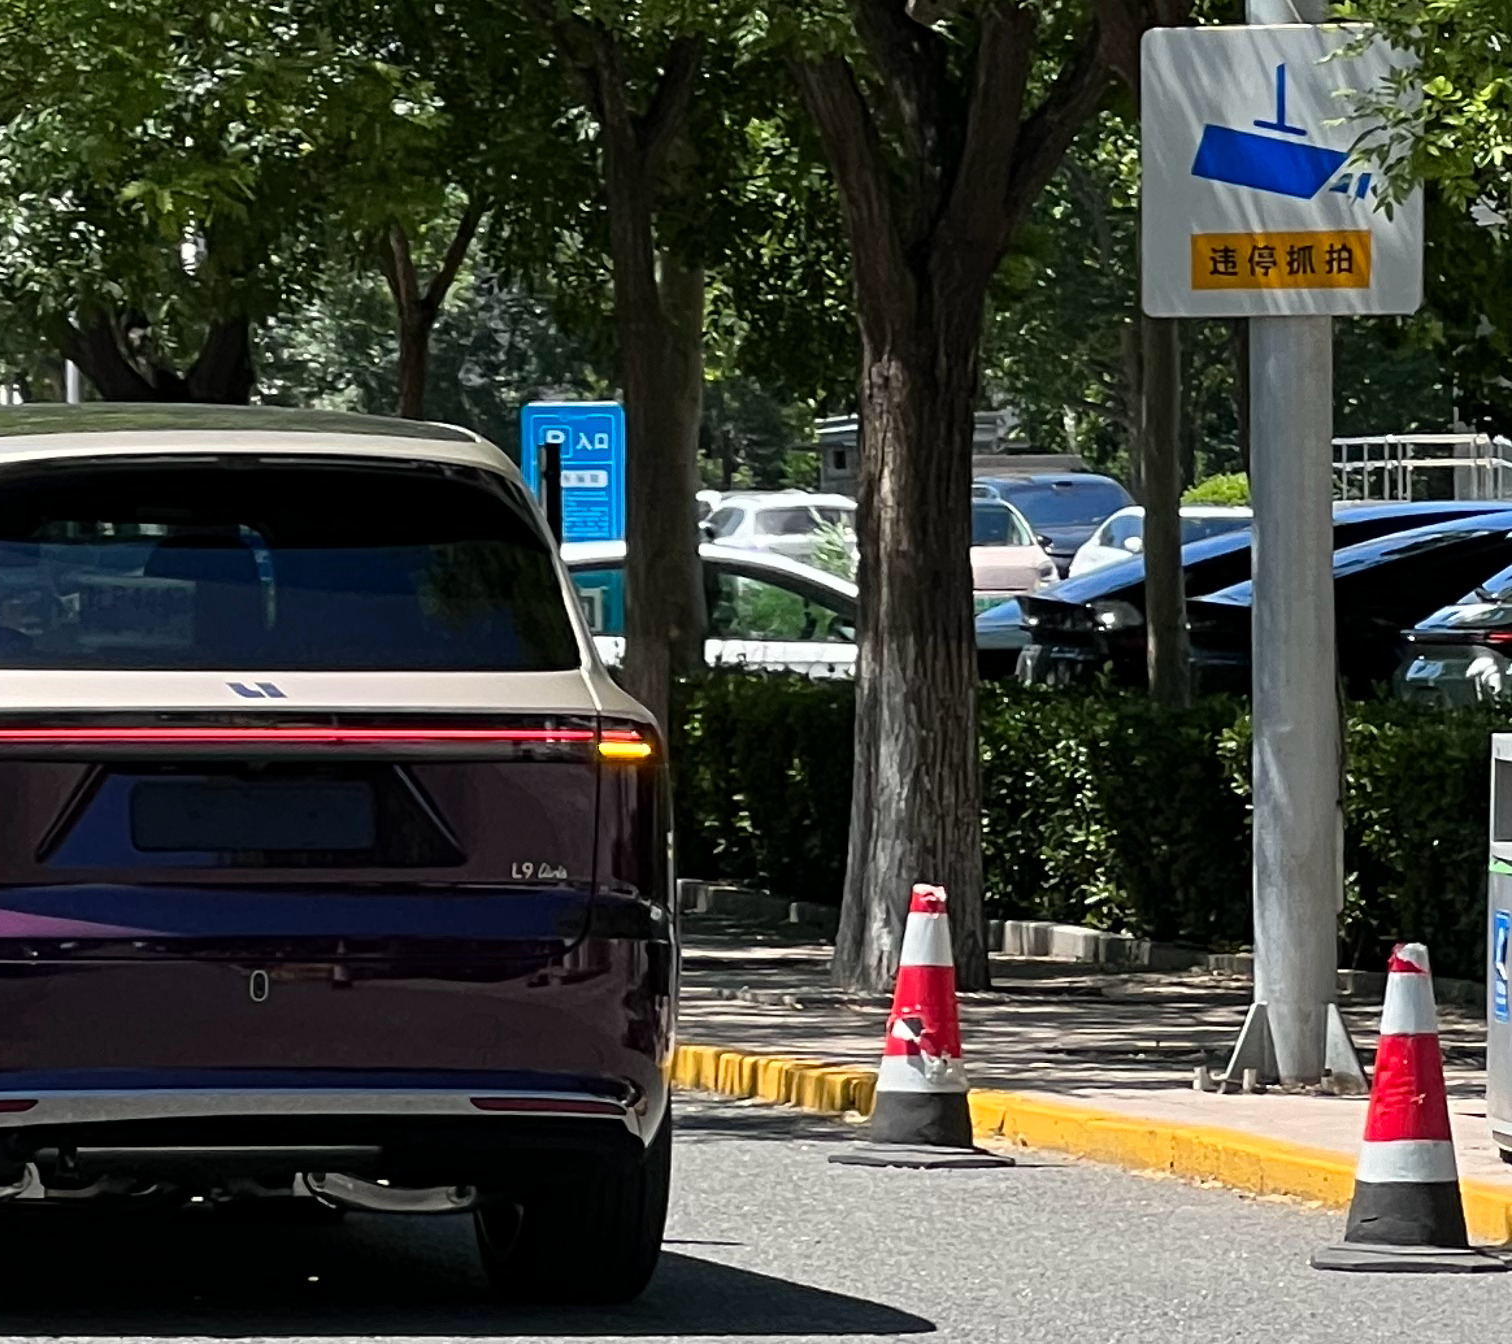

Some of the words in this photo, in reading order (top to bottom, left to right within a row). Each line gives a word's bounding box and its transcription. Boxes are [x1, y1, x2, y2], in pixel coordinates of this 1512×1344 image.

[1209, 243, 1354, 277] 违停抓拍
[575, 432, 609, 451] 入口
[512, 862, 534, 879] L9
